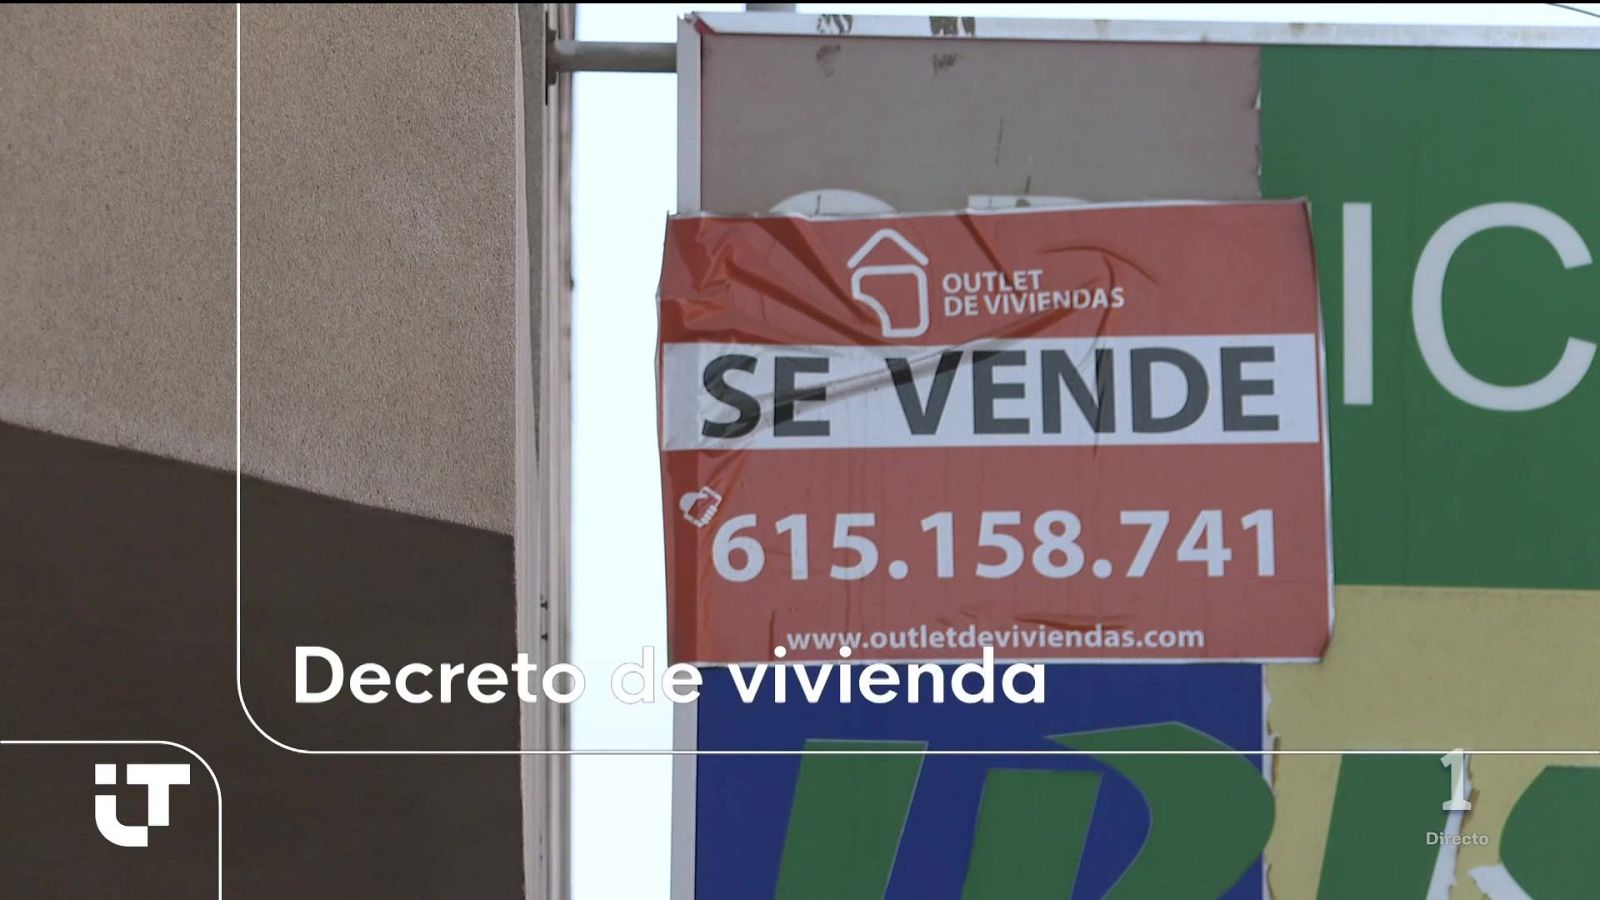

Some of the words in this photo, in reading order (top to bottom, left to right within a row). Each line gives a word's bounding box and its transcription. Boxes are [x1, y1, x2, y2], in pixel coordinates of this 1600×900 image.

[942, 269, 1043, 293] OUTLET
[943, 296, 979, 317] DE
[983, 287, 1125, 315] VIVIENDAS
[700, 353, 831, 438] SE
[886, 345, 1280, 436] VENDE
[711, 509, 1276, 583] 615.158.741
[786, 624, 1205, 651] www.outletdeviviendas.com
